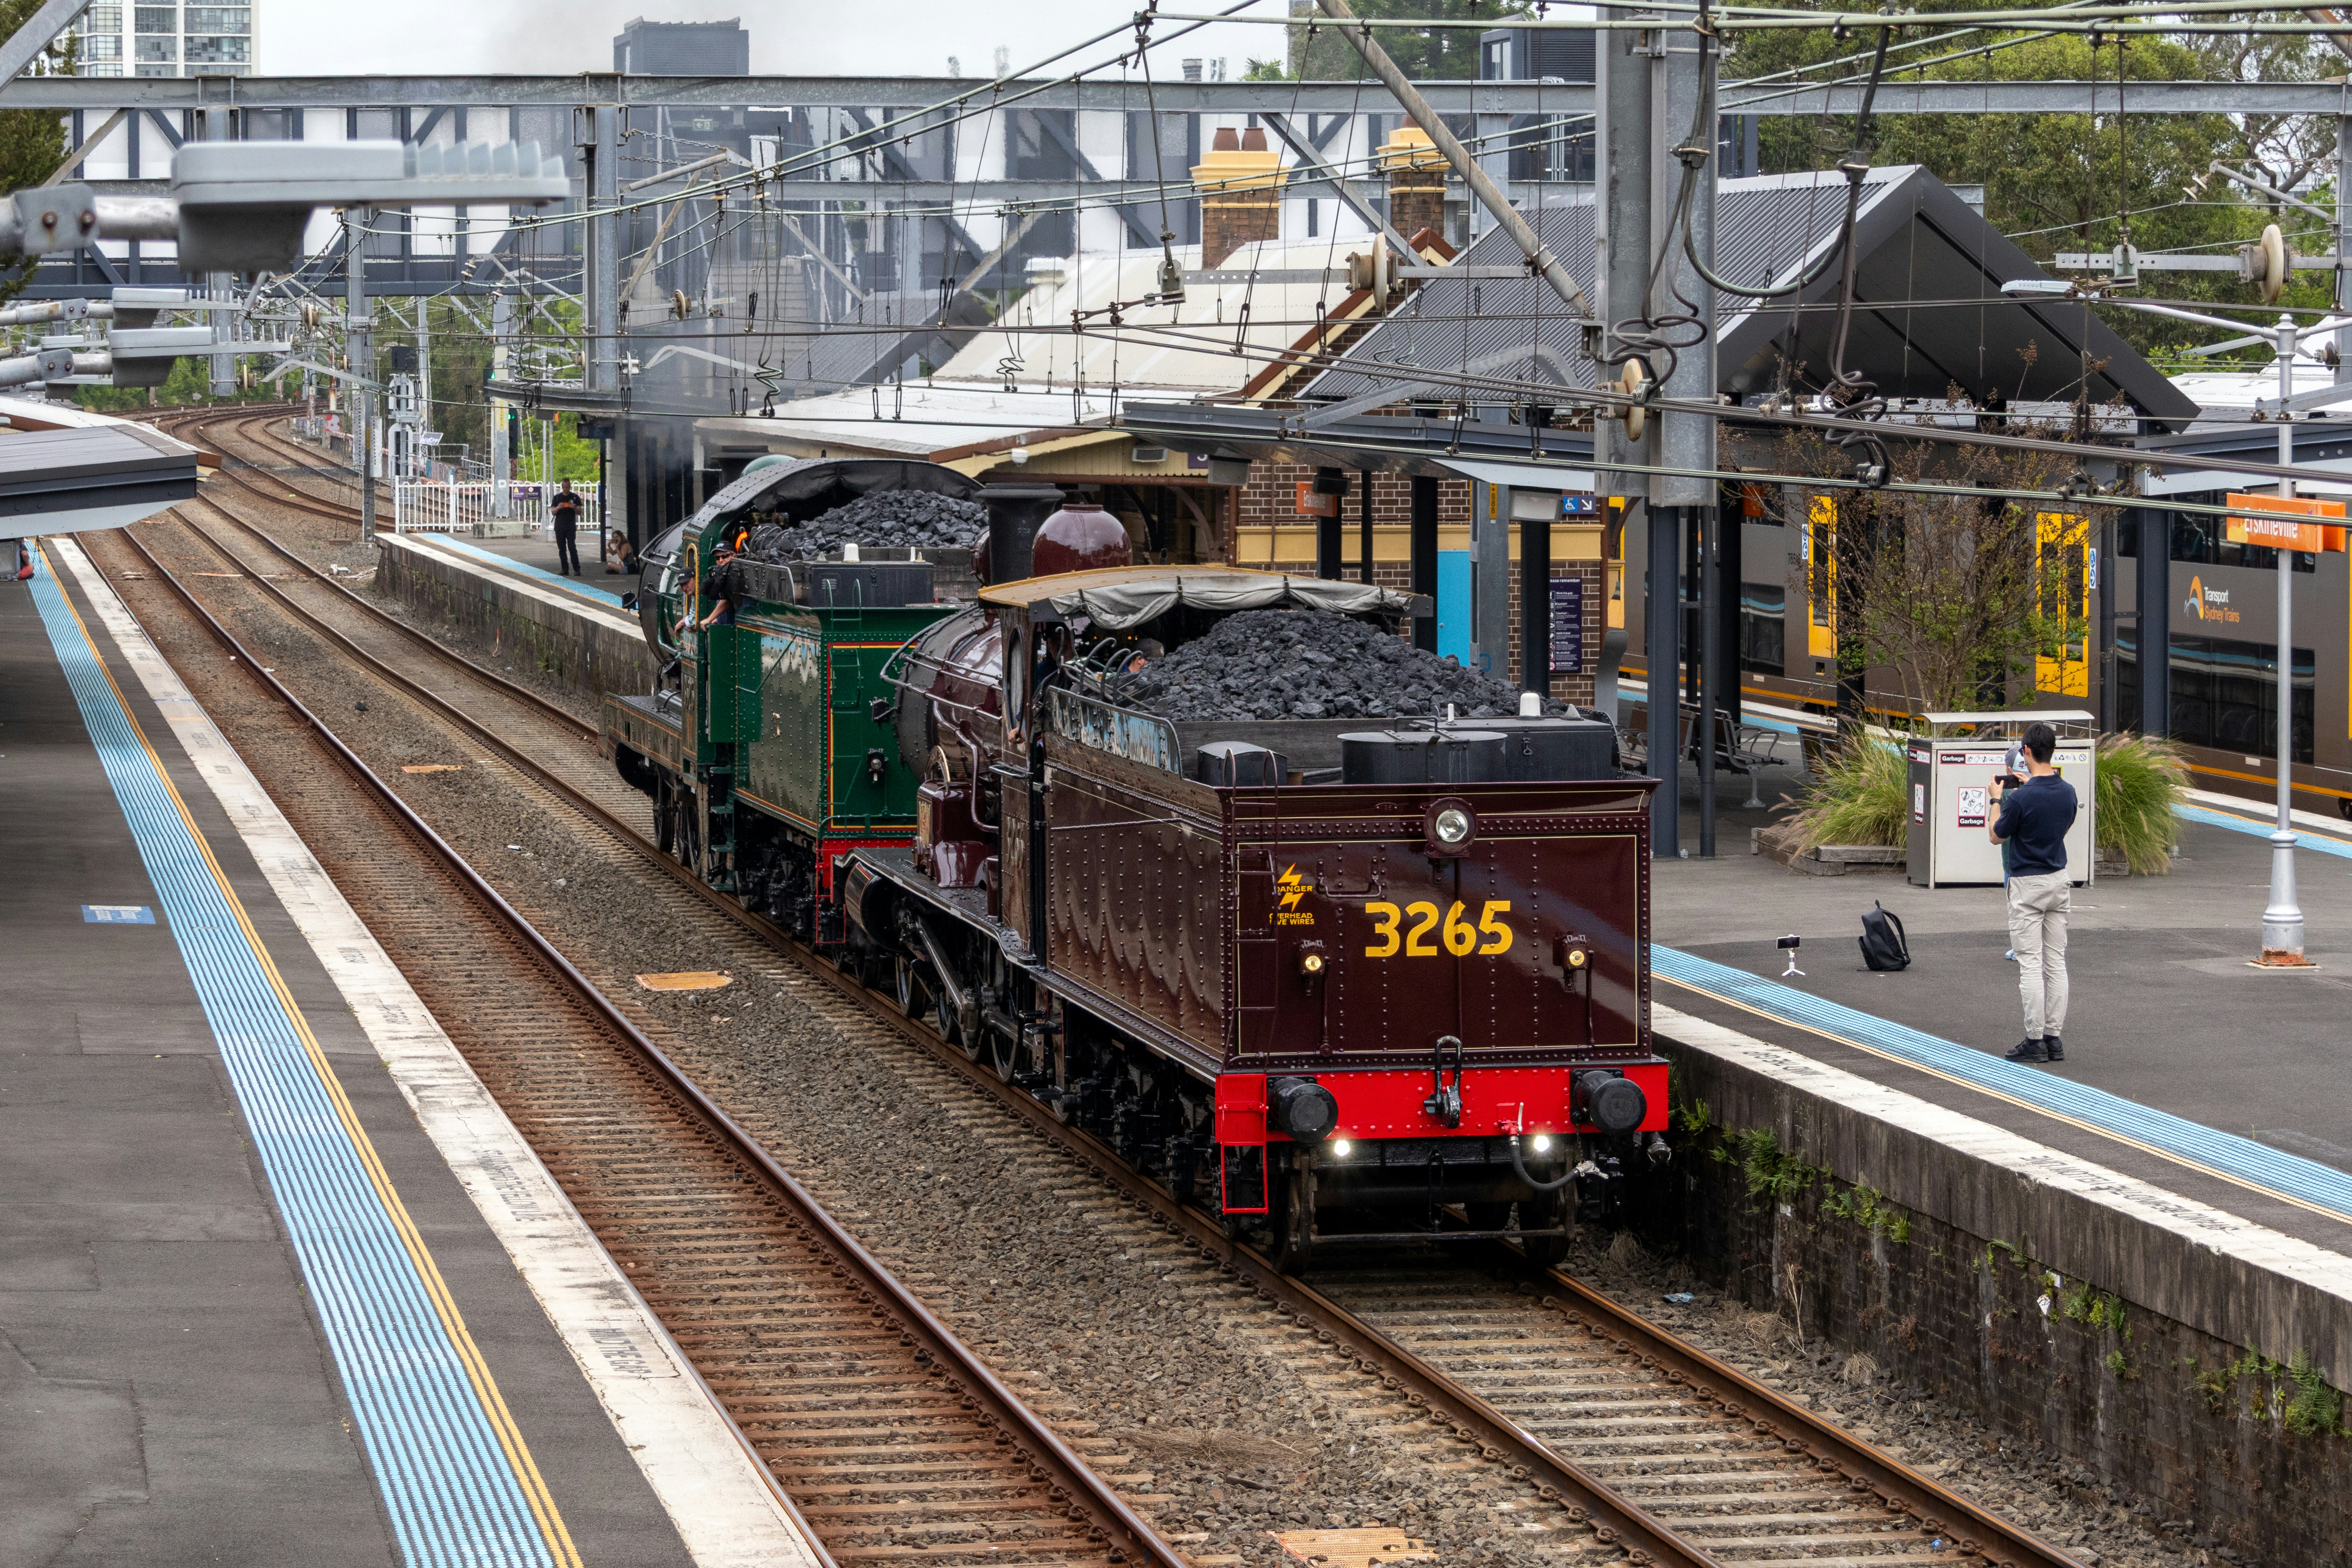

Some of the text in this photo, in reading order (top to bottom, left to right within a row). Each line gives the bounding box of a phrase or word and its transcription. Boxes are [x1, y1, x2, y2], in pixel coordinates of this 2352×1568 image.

[2244, 507, 2298, 539] Erskineville
[1788, 553, 1801, 565] T65
[2204, 587, 2228, 605] Transport
[2205, 605, 2239, 624] Sydney Trains
[1365, 901, 1513, 957] 3265
[586, 1328, 652, 1373] MIND THE GAP
